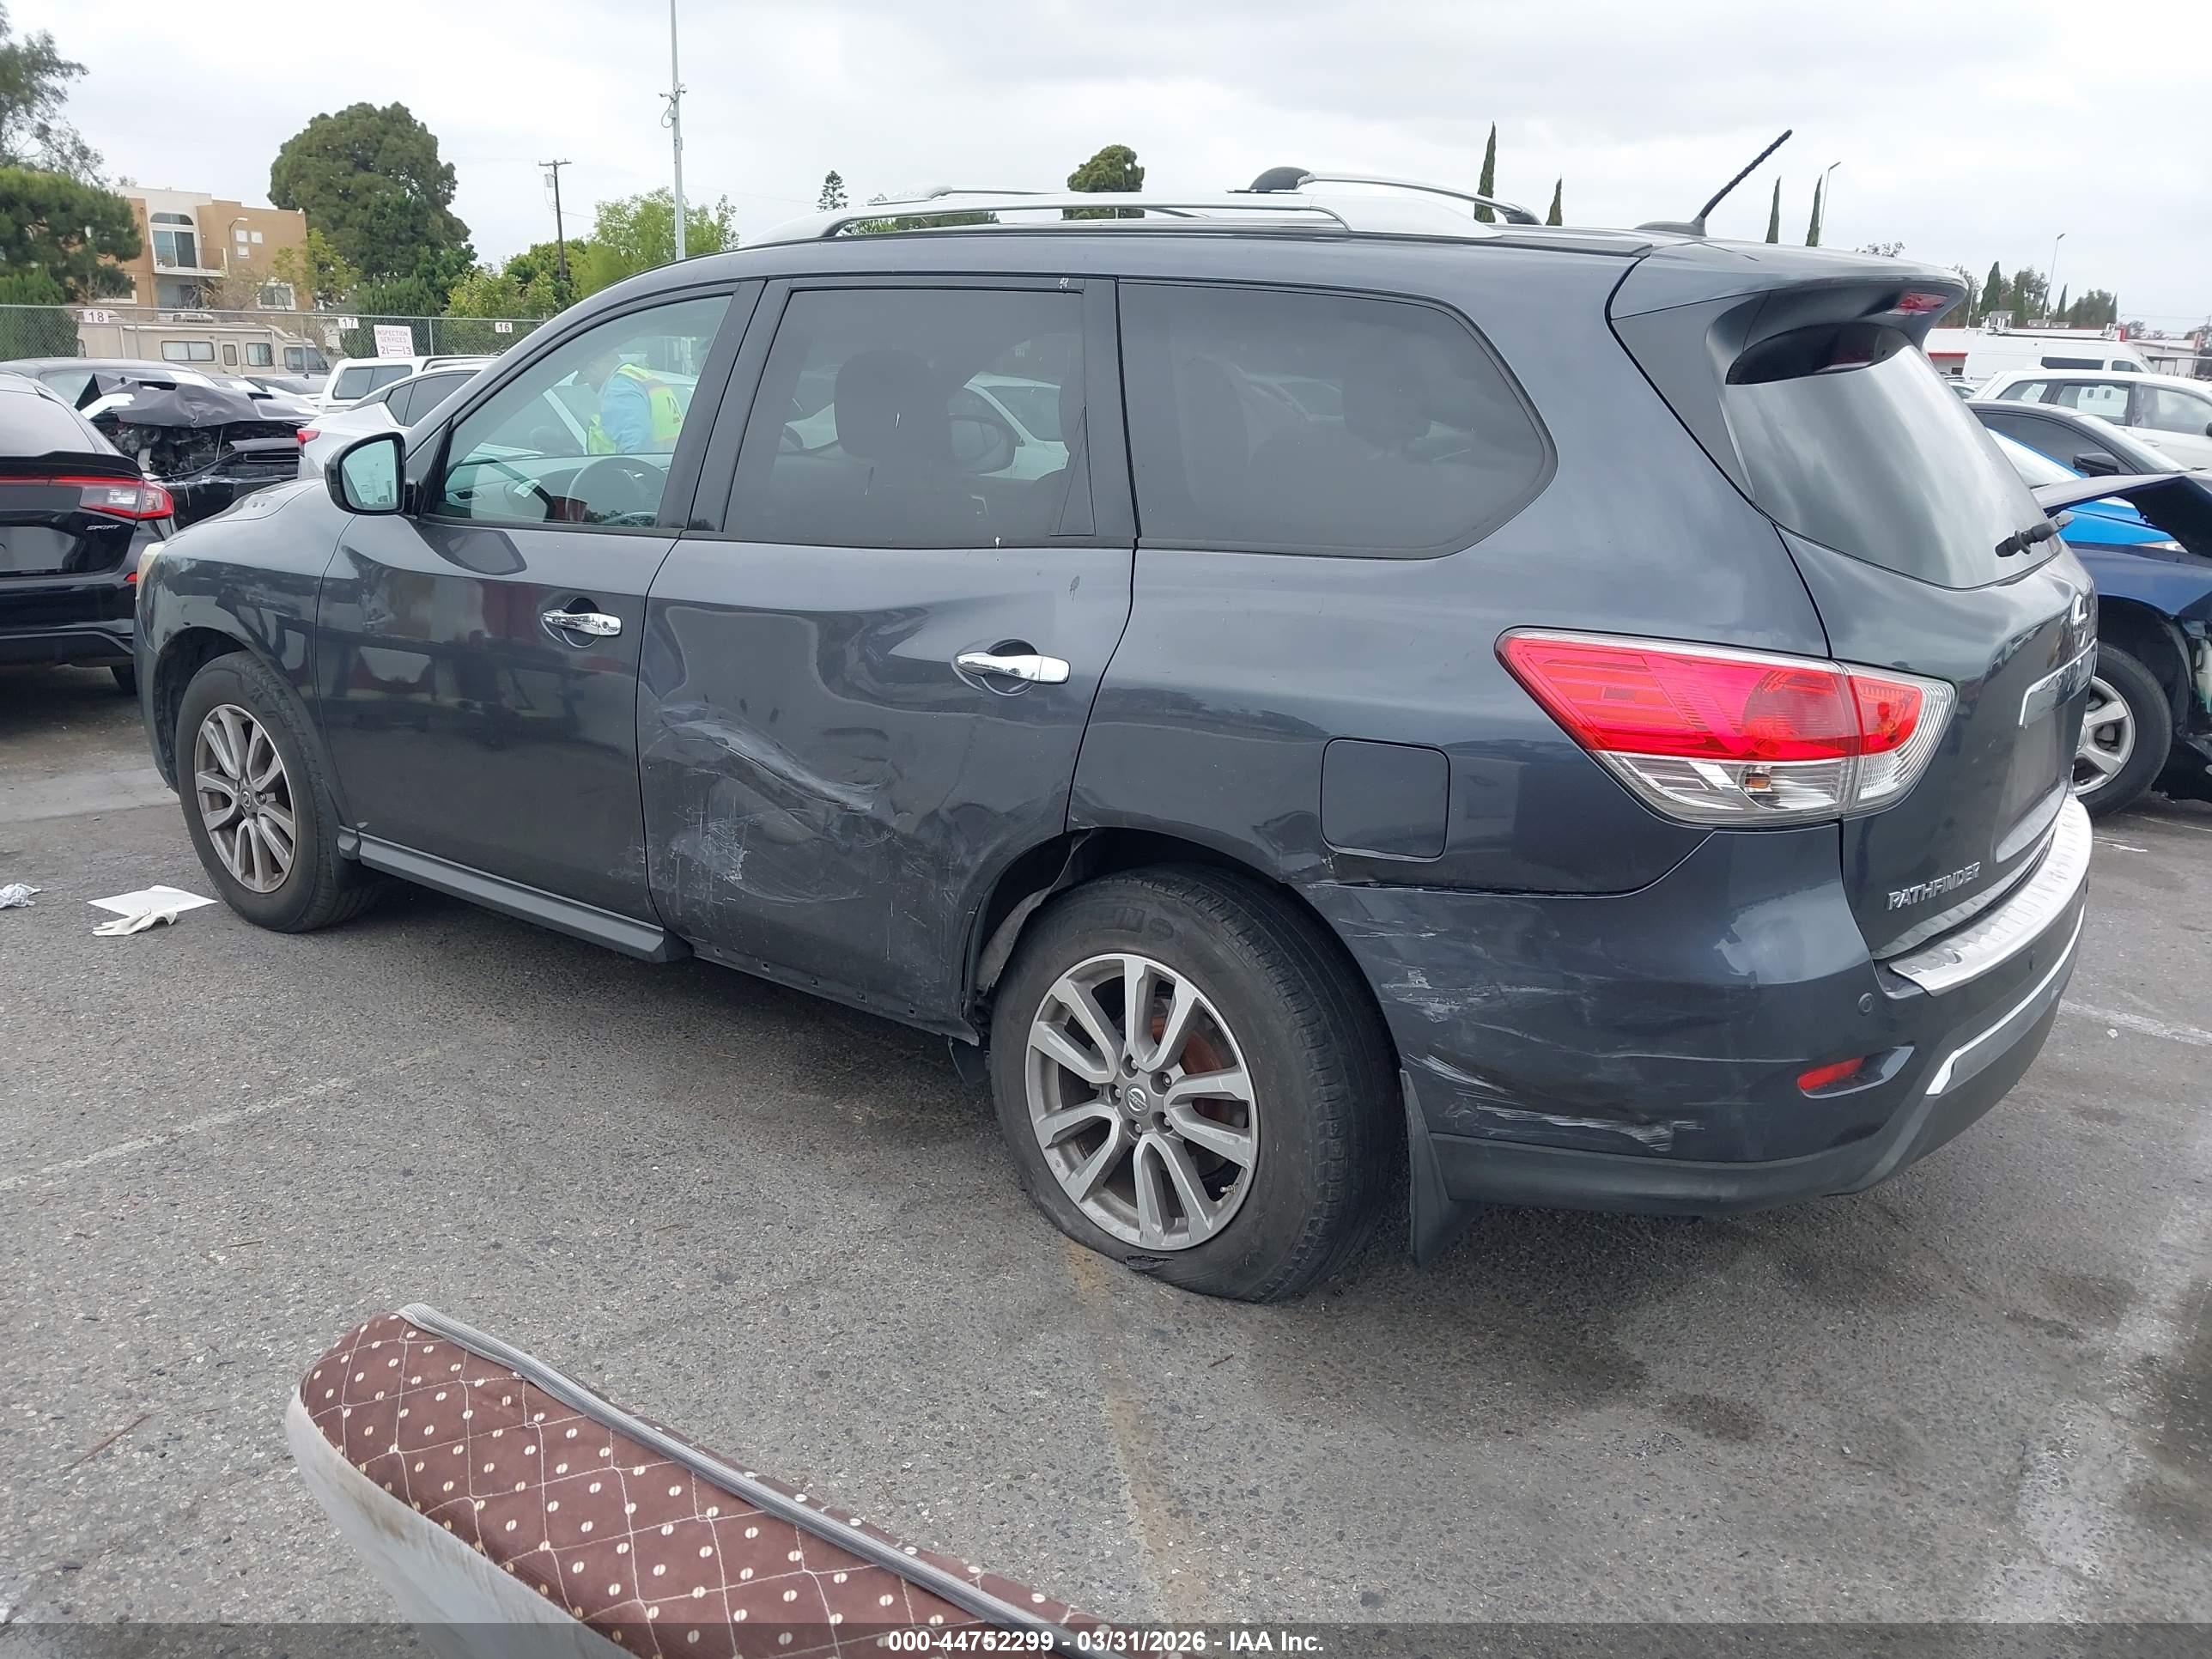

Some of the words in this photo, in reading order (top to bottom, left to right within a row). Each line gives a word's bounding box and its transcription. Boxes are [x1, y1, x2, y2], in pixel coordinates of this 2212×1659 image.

[88, 311, 105, 322] 18
[343, 318, 355, 328] 17
[499, 323, 510, 331] 16
[1888, 861, 1981, 911] PATHFINDER
